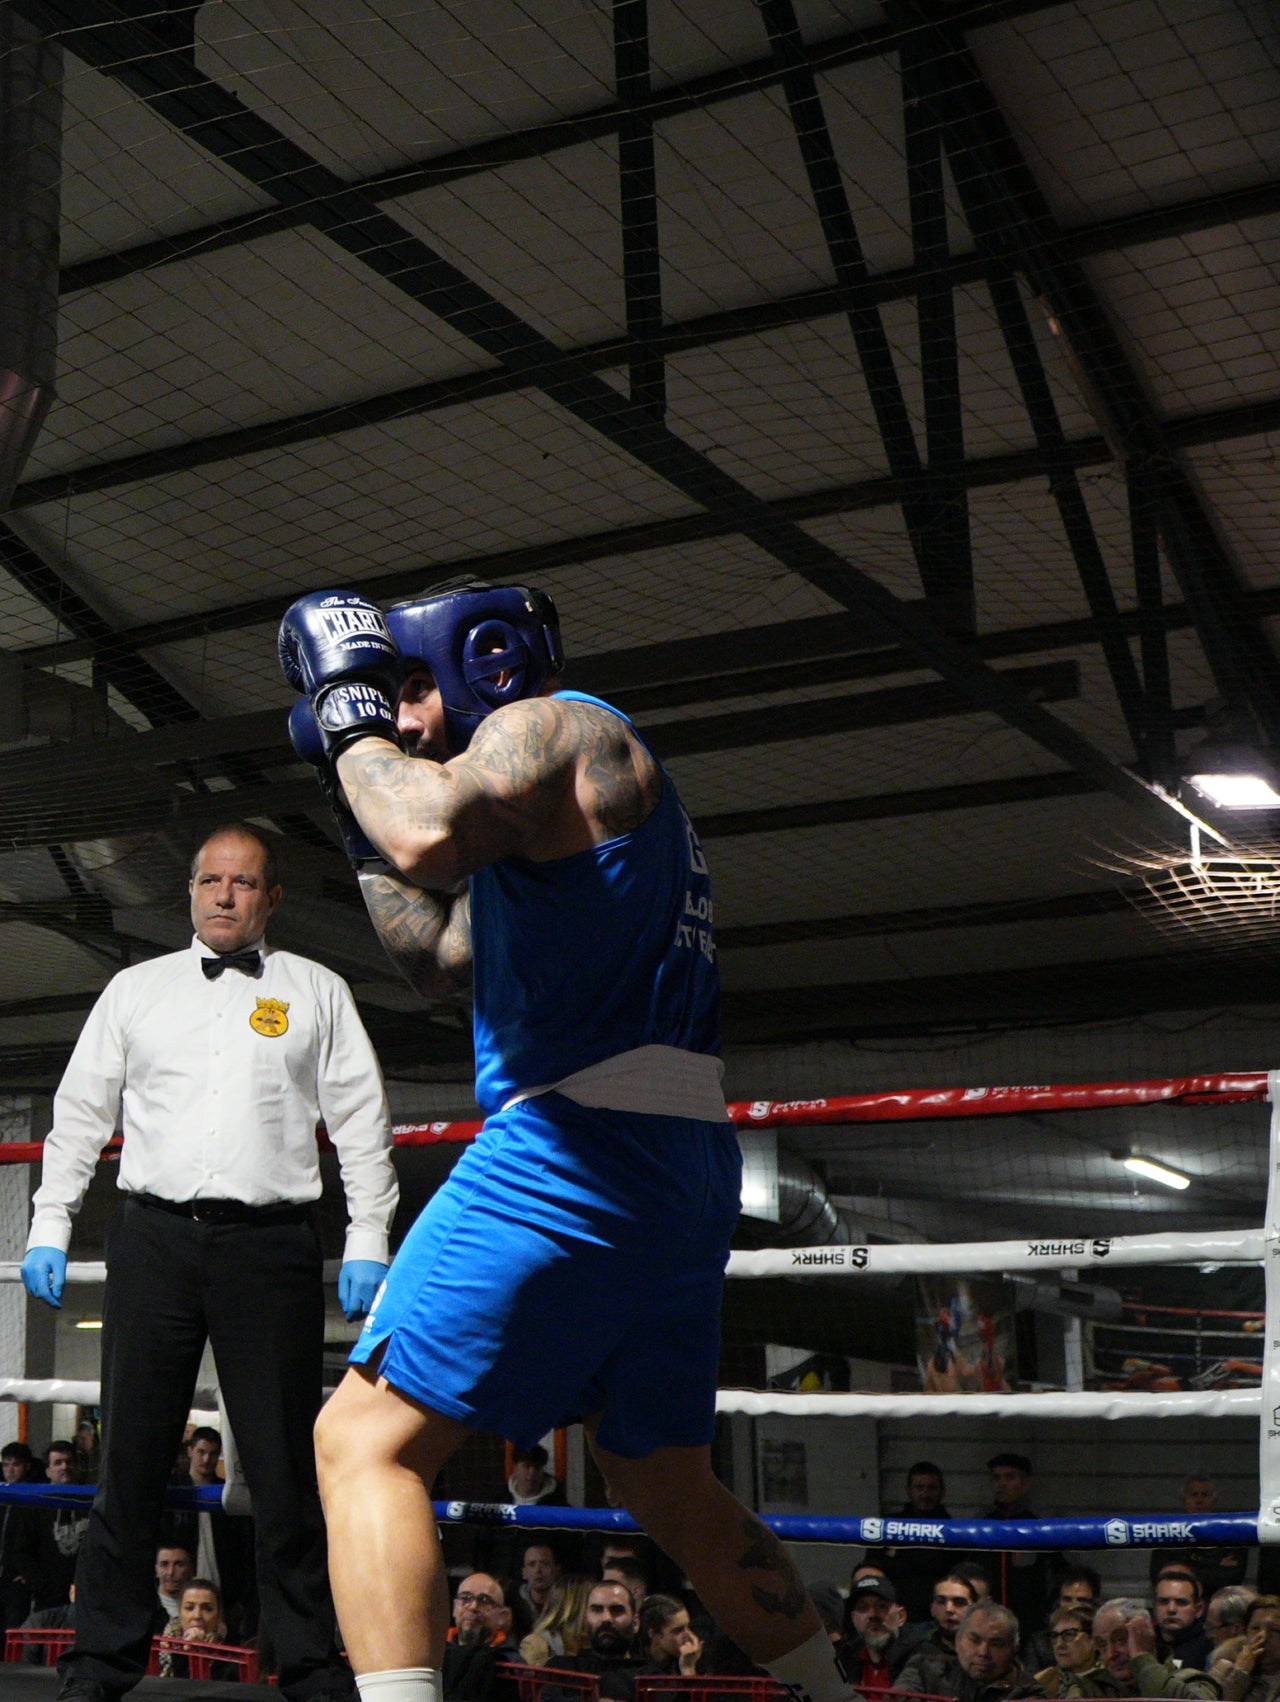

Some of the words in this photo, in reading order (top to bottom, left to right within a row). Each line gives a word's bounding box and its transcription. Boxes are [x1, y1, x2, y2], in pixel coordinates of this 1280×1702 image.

[356, 702, 376, 717] 10
[1027, 1243, 1085, 1256] SHARK
[792, 1253, 845, 1265] SHARK
[470, 1503, 519, 1516] SHARK
[887, 1521, 945, 1538] SHARK
[1132, 1522, 1195, 1538] SHARK
